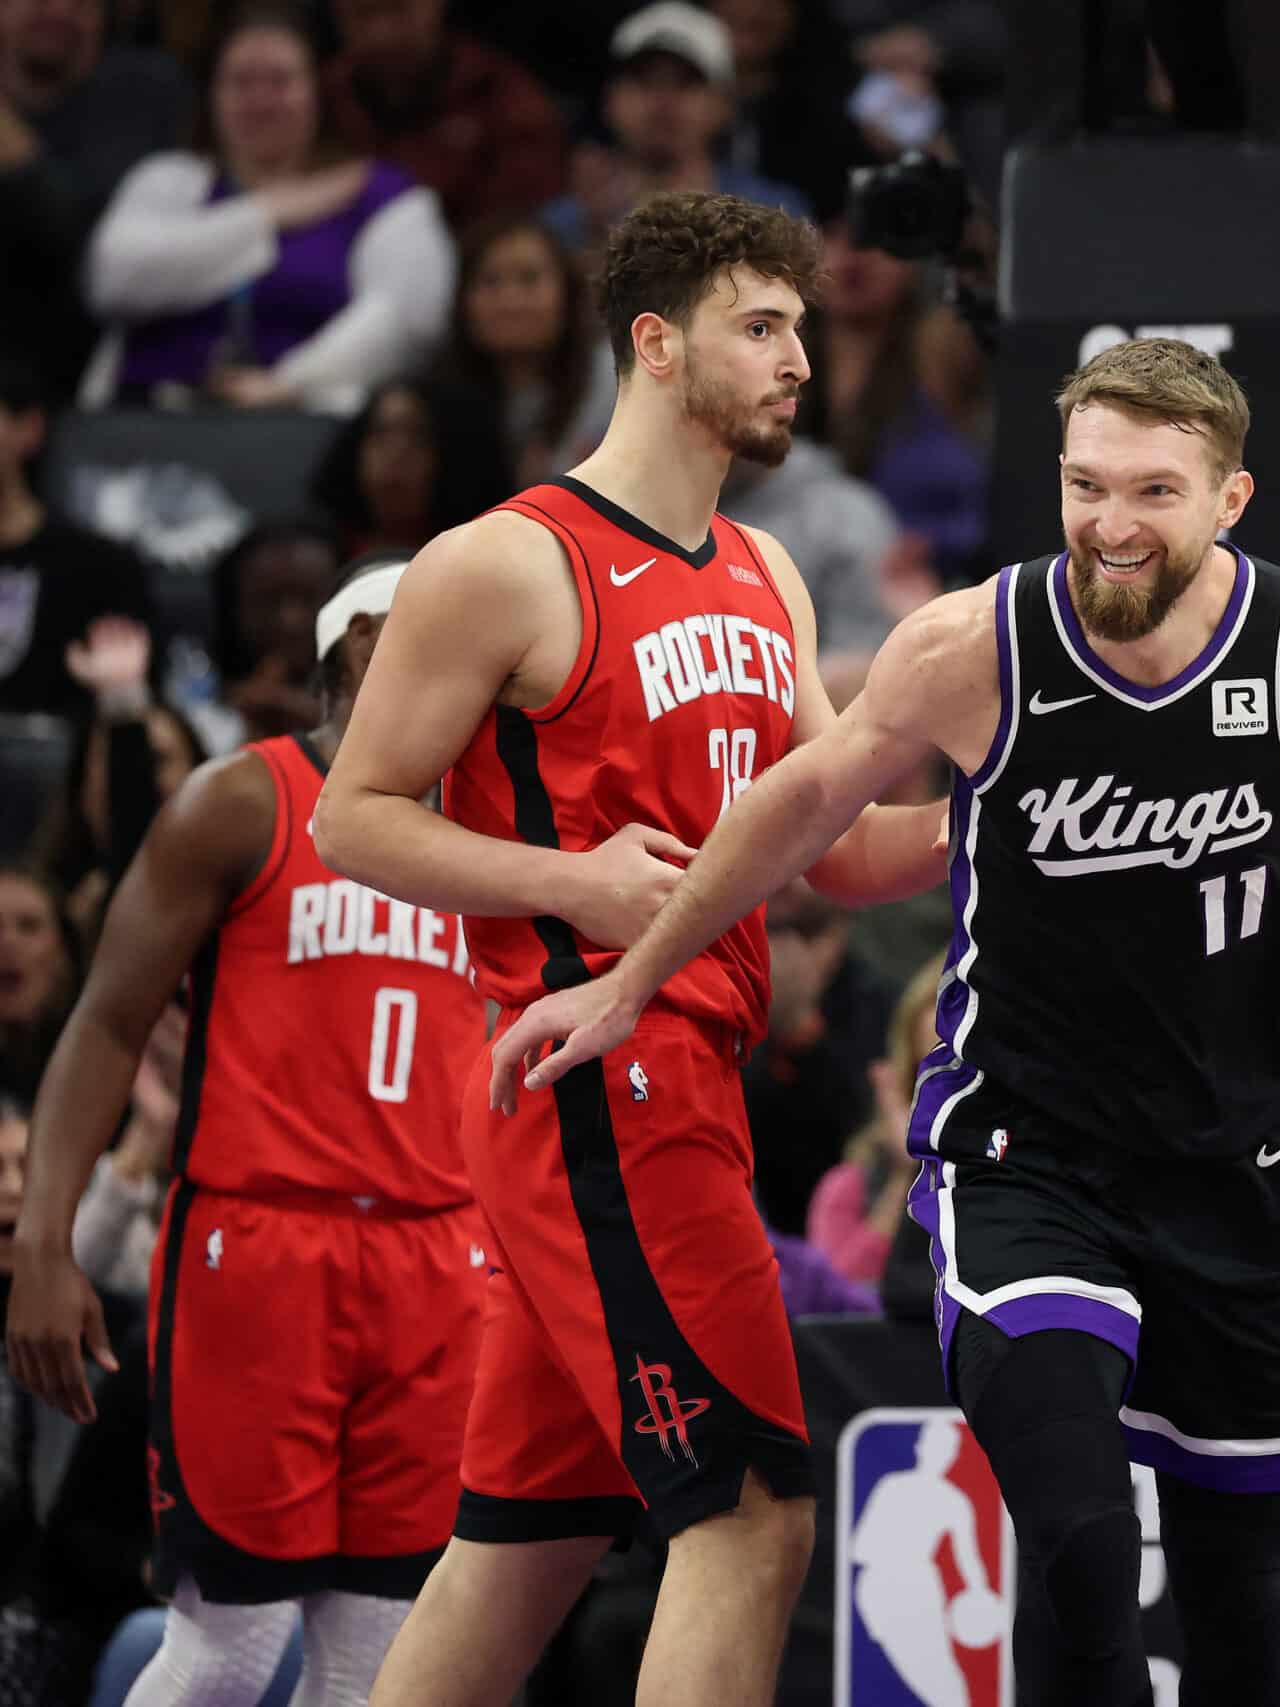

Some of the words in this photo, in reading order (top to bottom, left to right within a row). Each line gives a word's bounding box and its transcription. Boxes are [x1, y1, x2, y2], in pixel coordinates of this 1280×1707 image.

[632, 613, 795, 722] ROCKETS
[1225, 687, 1256, 715] R
[1216, 720, 1265, 730] REVIVER
[1018, 775, 1272, 877] Kings
[287, 879, 478, 991] ROCKE
[1199, 865, 1266, 956] 11
[368, 986, 418, 1103] 0
